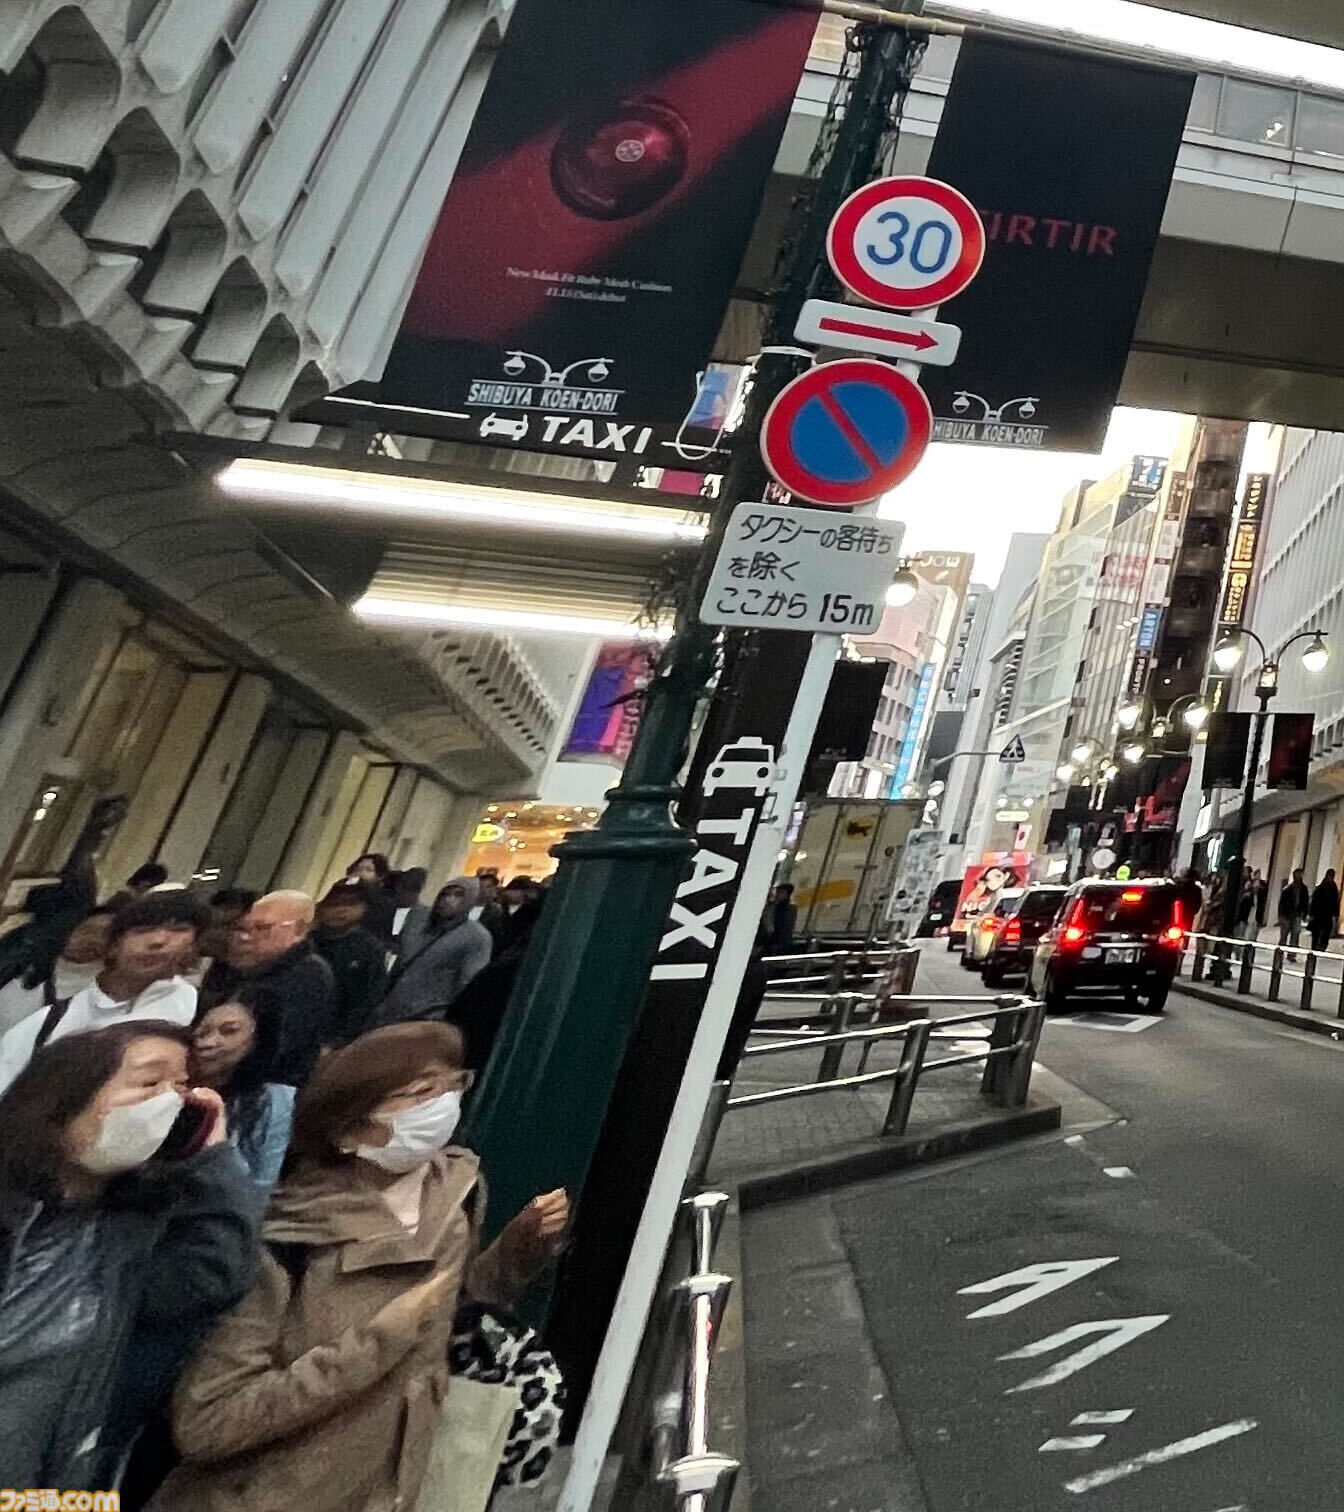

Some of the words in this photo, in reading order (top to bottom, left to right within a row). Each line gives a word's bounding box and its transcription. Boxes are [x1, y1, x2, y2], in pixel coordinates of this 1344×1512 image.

[866, 211, 952, 274] 30
[980, 209, 1118, 257] IRTIR
[467, 383, 533, 406] SHIBUYA
[540, 387, 619, 412] KOEN-DORI
[541, 416, 652, 454] TAXI
[932, 422, 976, 440] HIBUYA
[981, 424, 1044, 445] KOEN-DORI
[740, 514, 893, 555] タクシーの客待ち
[727, 551, 800, 581] を除く
[716, 587, 808, 619] ここから
[818, 593, 874, 626] 15m
[649, 807, 755, 981] TAXI
